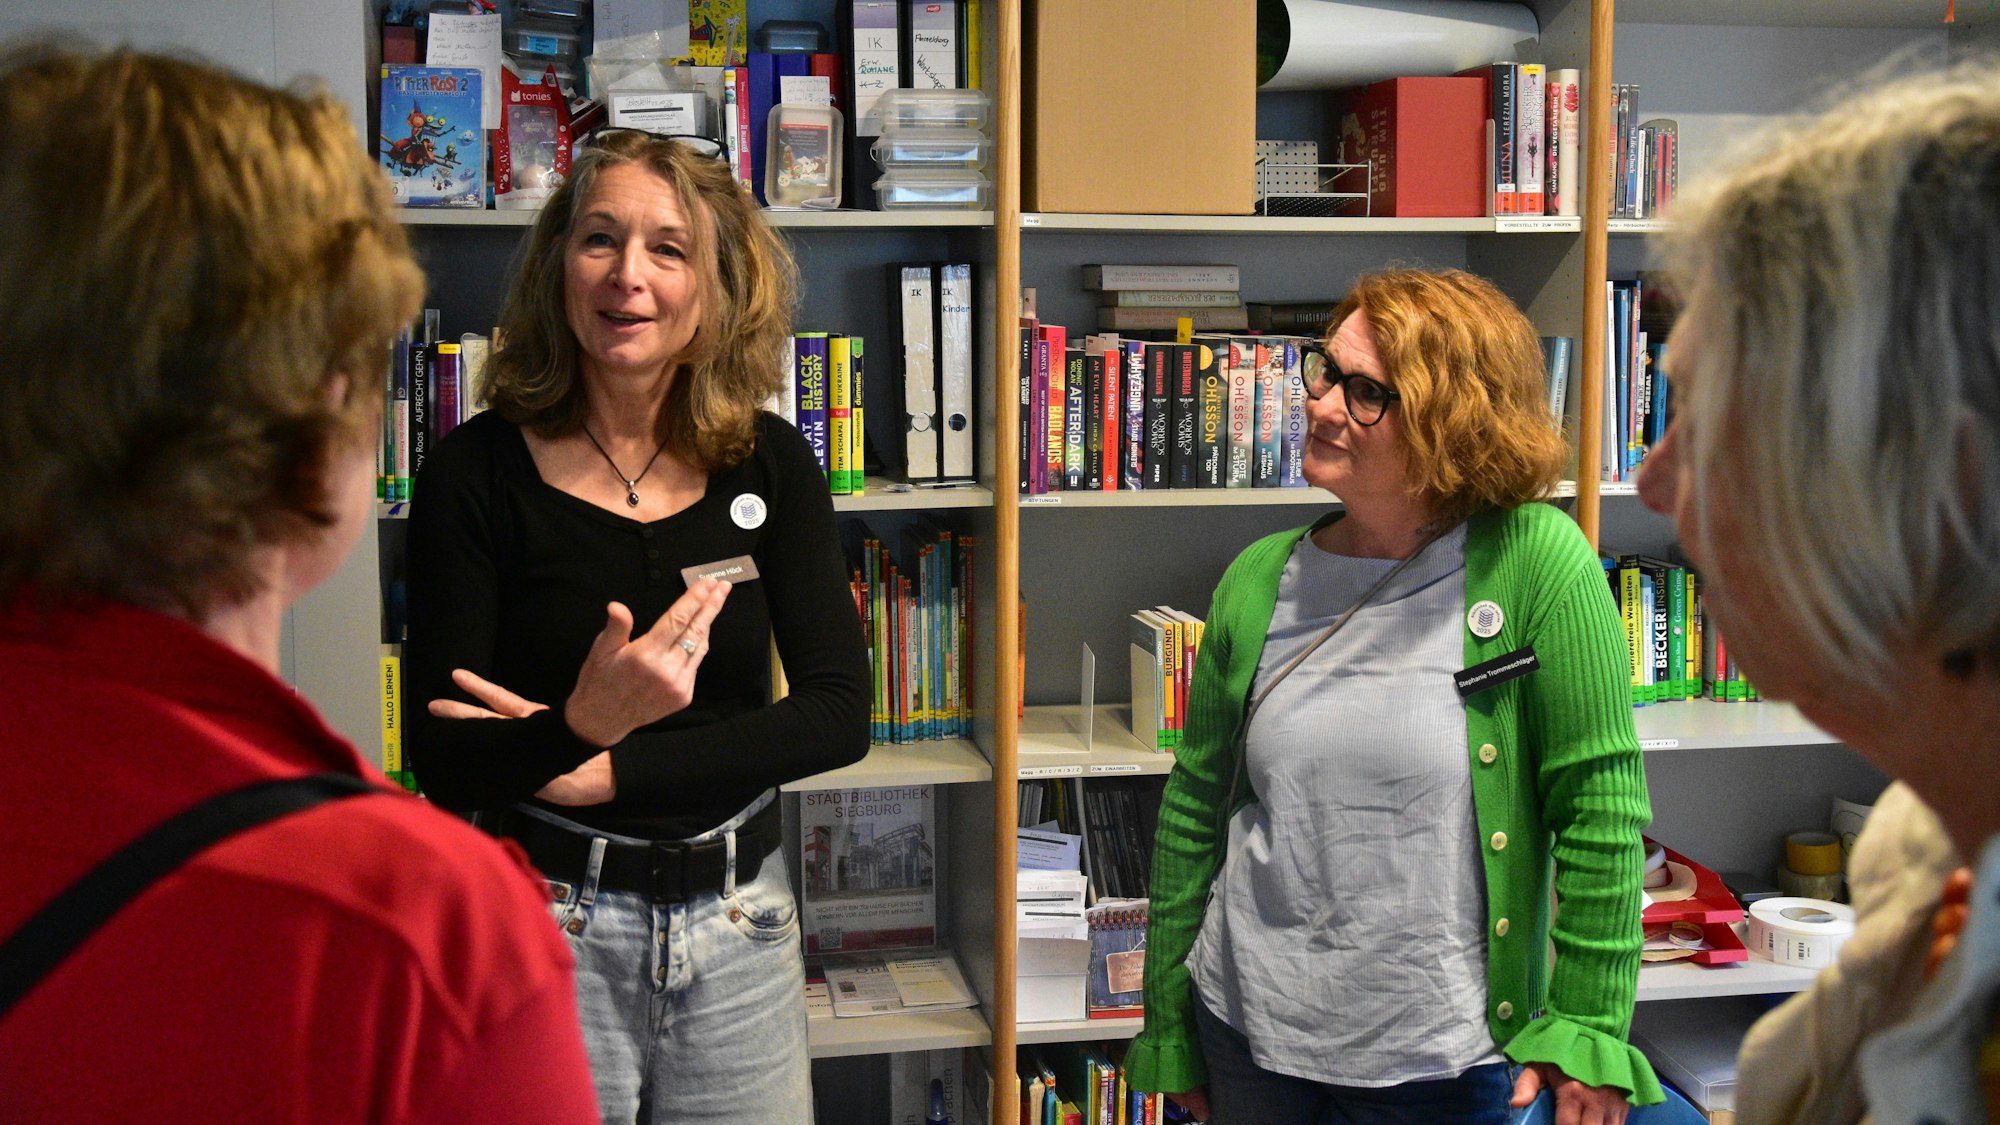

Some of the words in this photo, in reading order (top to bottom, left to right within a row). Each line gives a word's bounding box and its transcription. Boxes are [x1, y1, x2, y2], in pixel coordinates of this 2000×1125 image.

[394, 76, 429, 91] RITTER
[460, 78, 470, 92] 2
[522, 92, 552, 101] tonies
[1502, 102, 1510, 136] TERÉZIA
[1378, 153, 1387, 193] UND
[911, 288, 922, 296] IK
[942, 288, 953, 296] IK
[942, 305, 970, 313] Kinder
[801, 354, 813, 411] BLACK
[813, 353, 823, 410] HISTORY
[1093, 360, 1099, 372] AN
[1108, 366, 1116, 393] SILENT
[1127, 351, 1142, 412] UNGEZÄHMT
[415, 378, 424, 423] AUFRECHT
[1069, 386, 1082, 431] AFTER
[1107, 393, 1115, 421] PATIENT
[1205, 376, 1218, 443] OHLSSON
[1233, 376, 1245, 442] OHLSSON
[1261, 375, 1273, 443] OHLSSON
[1290, 376, 1301, 442] OHLSSON
[416, 431, 424, 452] Roos
[1047, 405, 1063, 463] BADLANDS
[1131, 422, 1139, 441] DOYLE
[1158, 412, 1167, 456] SCARROW
[1184, 411, 1193, 456] SCARROW
[1068, 434, 1081, 473] DARK
[1211, 445, 1219, 485] SPÄTSOMMER
[1231, 455, 1239, 483] STURM
[1238, 459, 1246, 480] TOTE
[744, 518, 760, 526] 2025
[1656, 572, 1665, 608] INSIDE
[1673, 572, 1681, 597] Crime
[1674, 598, 1682, 623] Green
[1165, 628, 1173, 677] BURGUND
[1655, 612, 1668, 669] BECKER
[386, 664, 394, 699] LERNEN!
[1458, 673, 1487, 688] Stephanie
[386, 701, 394, 729] HALLO
[807, 787, 929, 806] STADTBIBLIOTHEK
[835, 803, 902, 818] SIEGBURG
